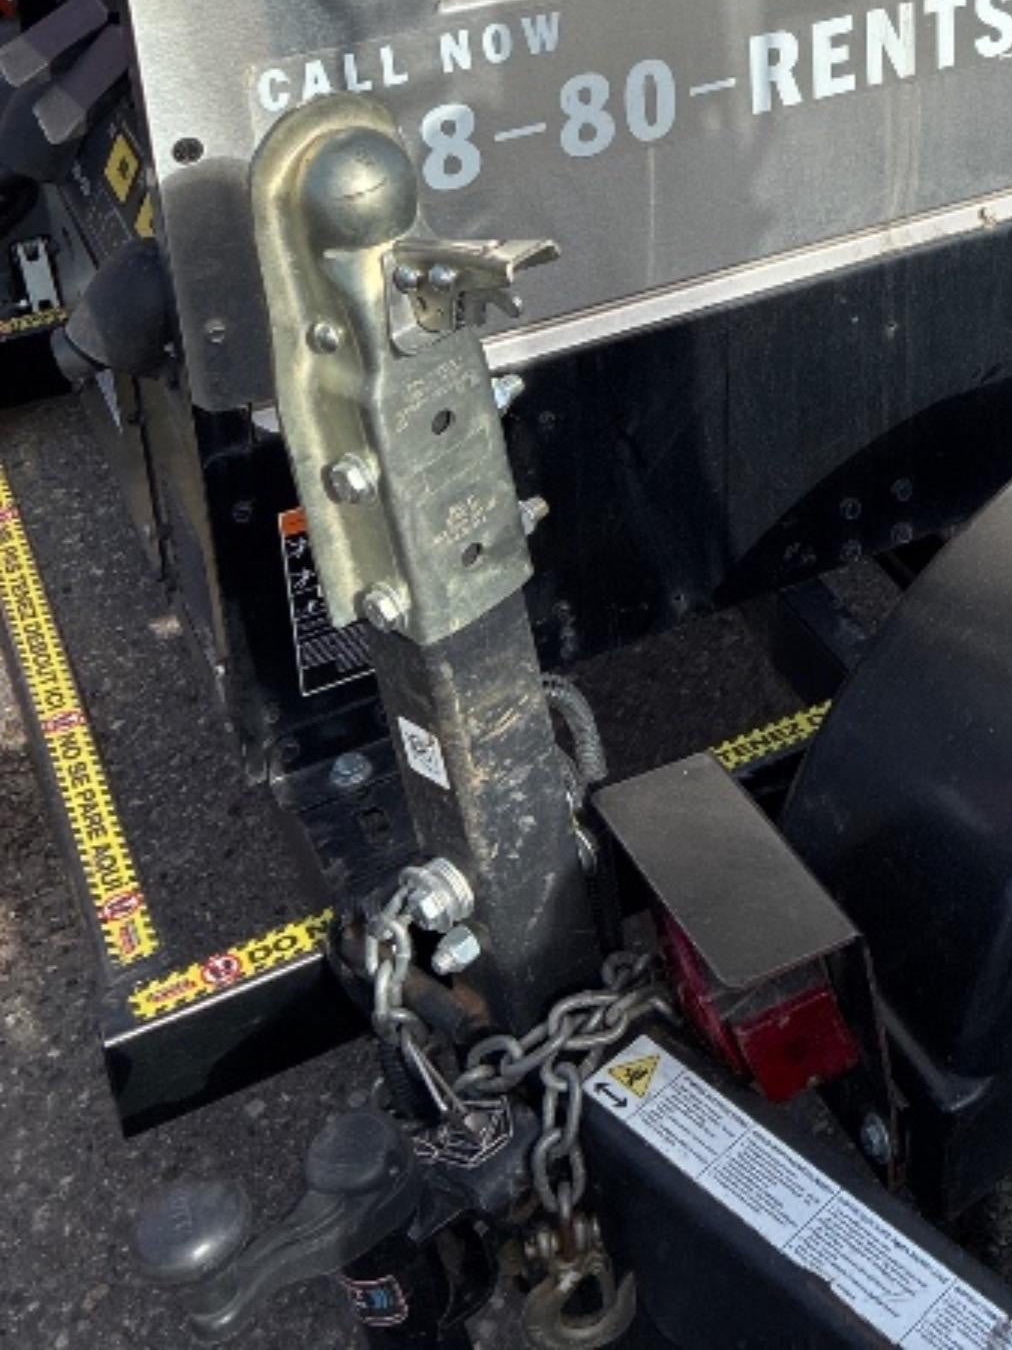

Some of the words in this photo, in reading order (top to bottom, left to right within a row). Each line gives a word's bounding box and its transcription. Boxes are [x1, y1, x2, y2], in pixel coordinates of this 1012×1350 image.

[257, 44, 409, 112] CALL
[440, 11, 563, 74] NOW
[58, 731, 82, 760] NO
[67, 761, 91, 789] SE
[74, 787, 108, 841] PARE
[248, 935, 298, 963] DO
